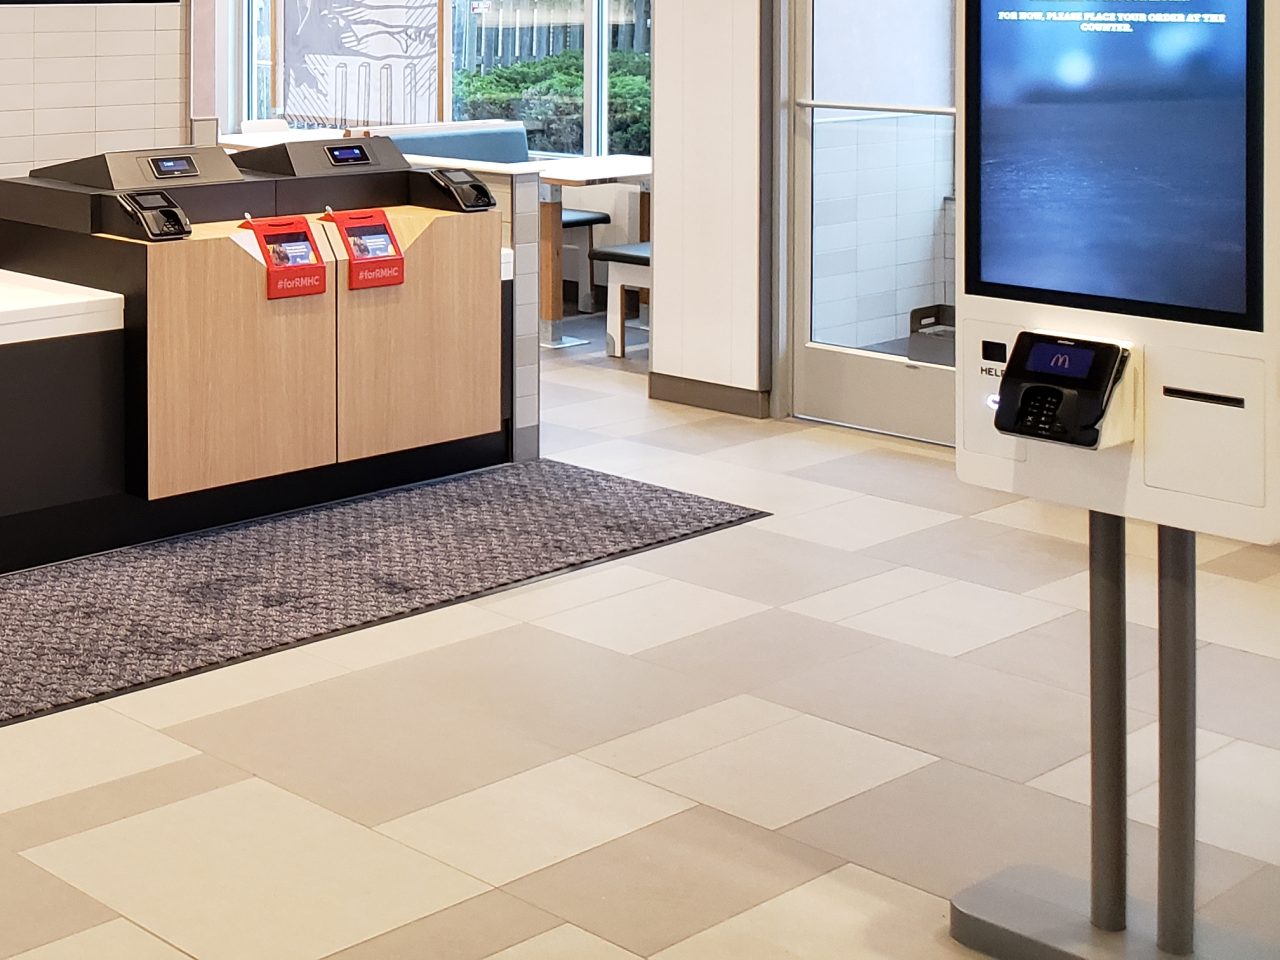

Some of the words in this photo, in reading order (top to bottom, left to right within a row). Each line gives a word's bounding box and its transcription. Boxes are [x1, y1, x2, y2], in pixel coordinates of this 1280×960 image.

[998, 12, 1018, 20] FOR
[1019, 12, 1045, 21] NOW,
[1046, 12, 1082, 21] PLEASE
[1083, 12, 1116, 22] PLACE
[1116, 13, 1147, 22] YOUR
[1148, 13, 1185, 22] ORDER
[1186, 14, 1201, 22] AT
[1201, 14, 1226, 23] THE
[1080, 23, 1133, 32] COUNTER.
[359, 267, 399, 280] #forRMHC
[277, 276, 320, 289] #forRMHC
